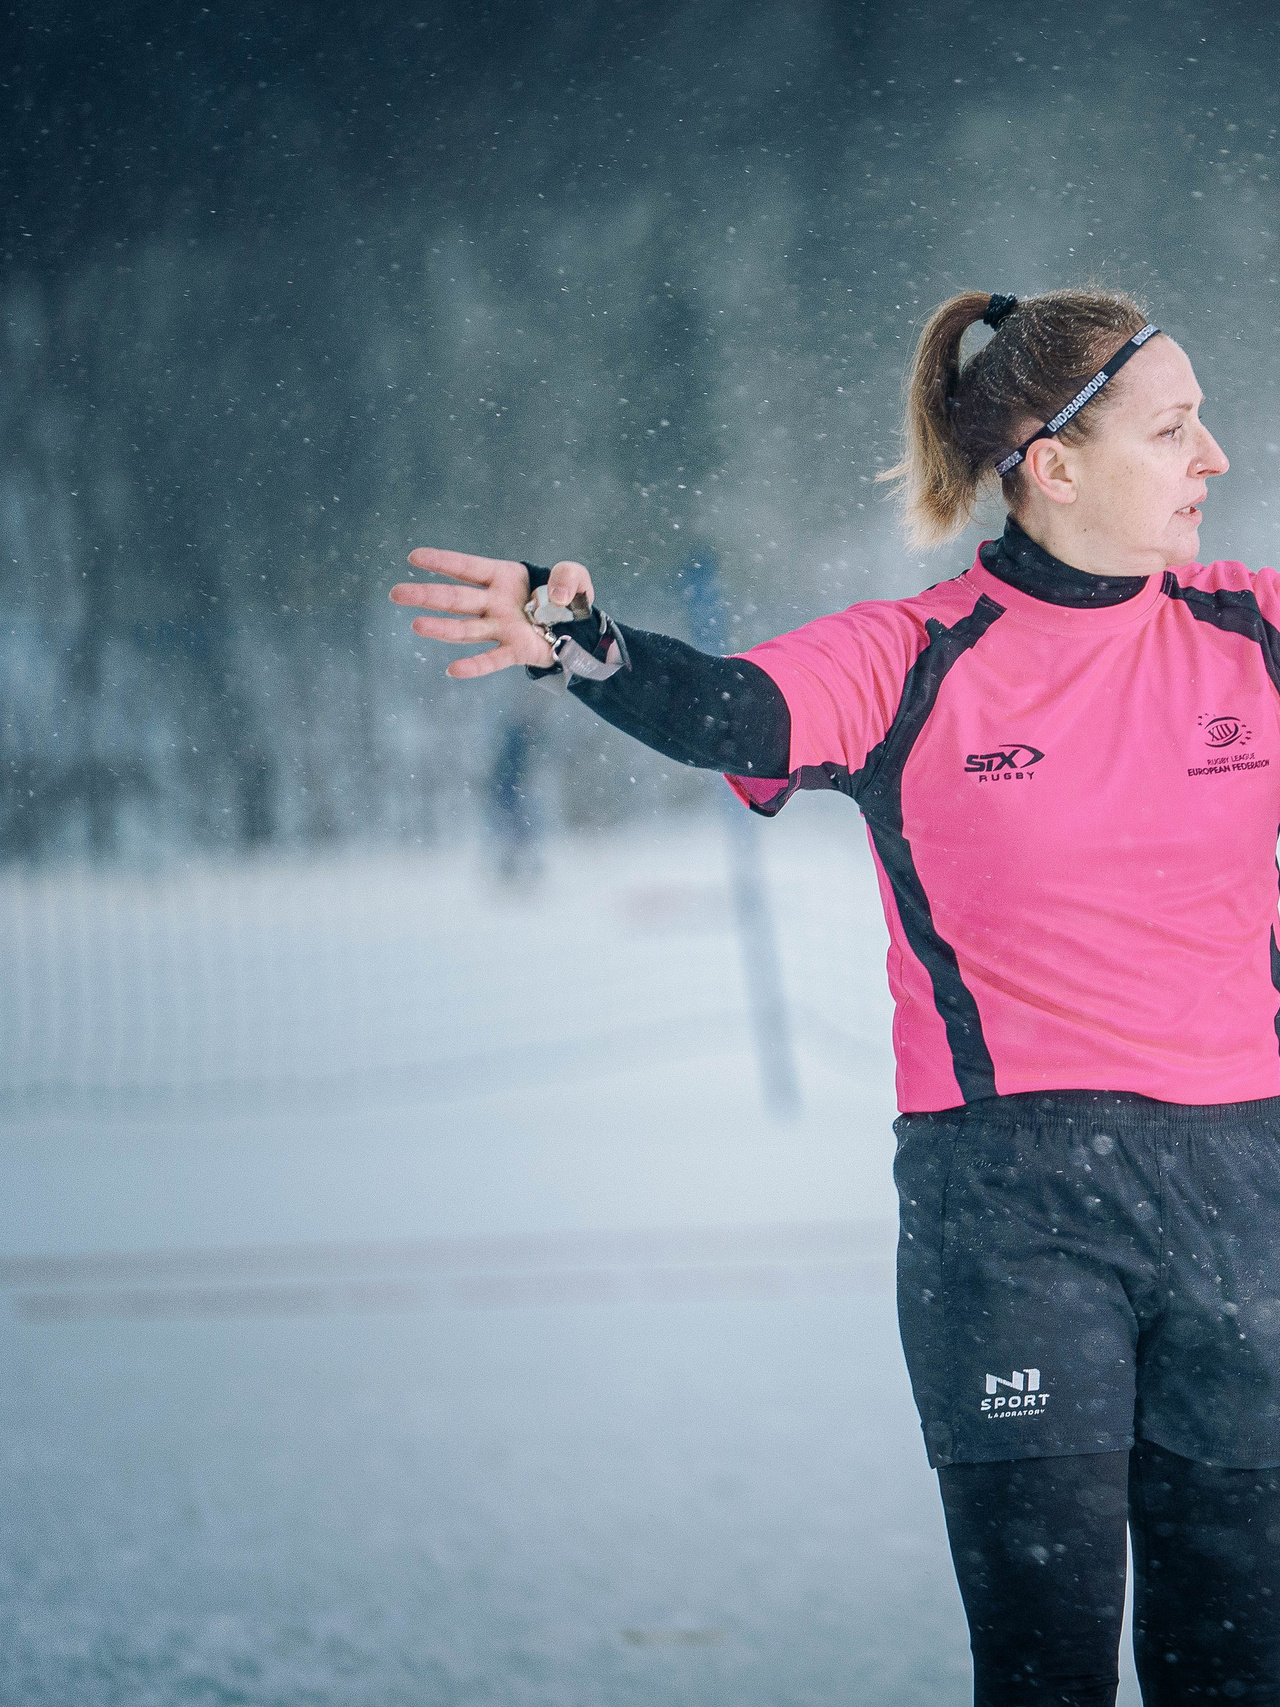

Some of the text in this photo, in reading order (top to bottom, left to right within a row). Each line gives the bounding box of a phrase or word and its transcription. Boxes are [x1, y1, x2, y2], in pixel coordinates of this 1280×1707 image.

[1047, 371, 1109, 433] UNDERARMOUR
[1207, 723, 1233, 742] XIII
[1207, 752, 1256, 765] RUGBY LEAGUE
[1187, 759, 1270, 776] EUROPEAN FEDERATION
[979, 771, 1034, 783] RUGBY
[985, 1368, 1040, 1395] N1
[980, 1393, 1050, 1411] SPORT
[987, 1408, 1046, 1419] LABORATORY
